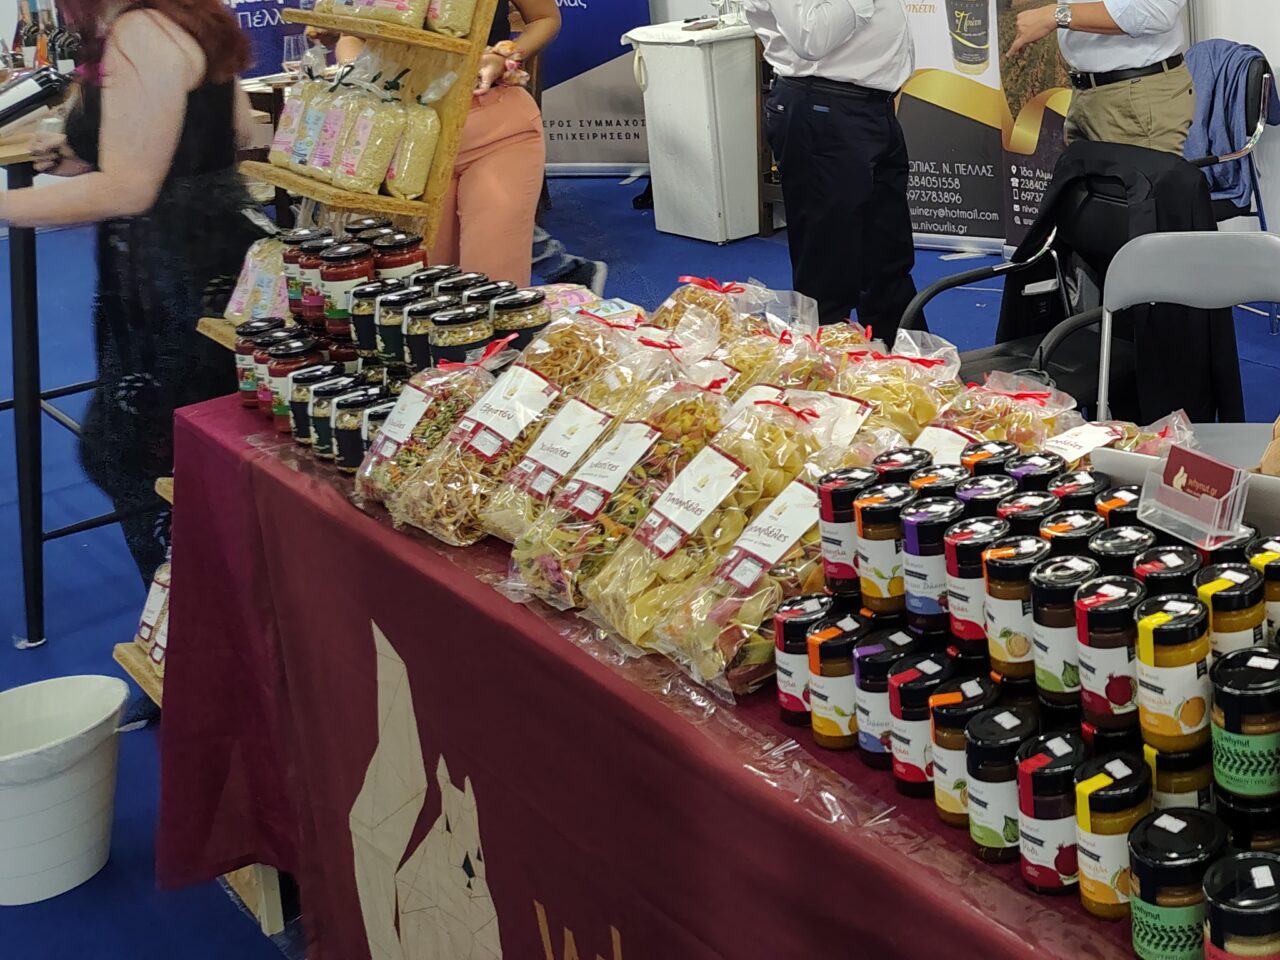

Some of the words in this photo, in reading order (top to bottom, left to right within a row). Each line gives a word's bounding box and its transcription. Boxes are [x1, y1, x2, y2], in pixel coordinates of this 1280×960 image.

[579, 119, 647, 128] ΣΥΜΜΑΧΟΣ
[955, 163, 994, 177] ΠΕΛΛΑΣ
[908, 176, 961, 190] 384051558
[910, 206, 999, 221] winery@hotmail.com
[912, 221, 968, 235] w.nivourlis.gr
